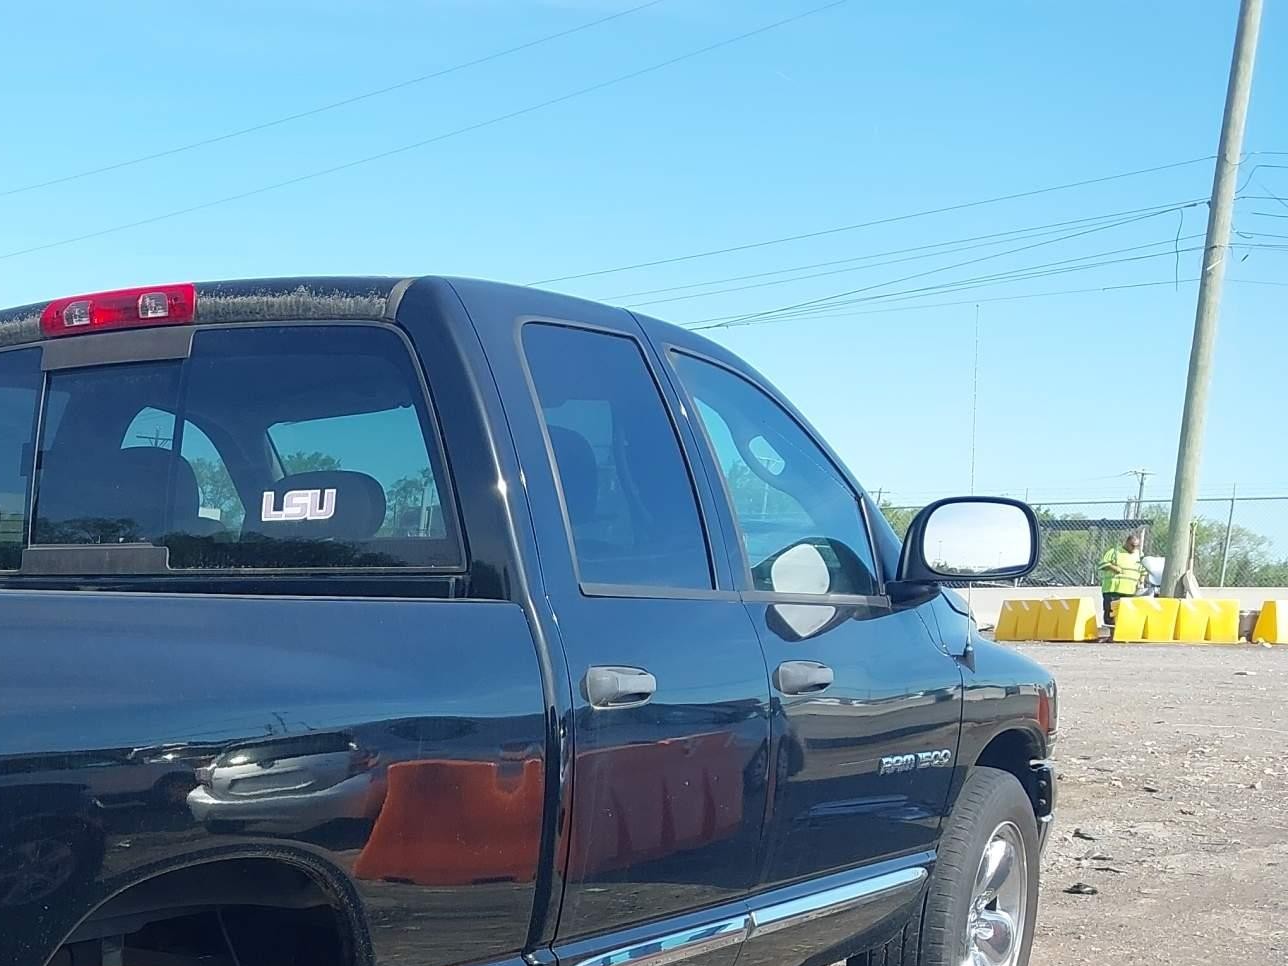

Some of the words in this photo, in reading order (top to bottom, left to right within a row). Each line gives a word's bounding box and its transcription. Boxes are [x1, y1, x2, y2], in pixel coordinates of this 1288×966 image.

[261, 488, 337, 522] LSU
[879, 754, 916, 776] RAM
[916, 749, 952, 769] 1500
